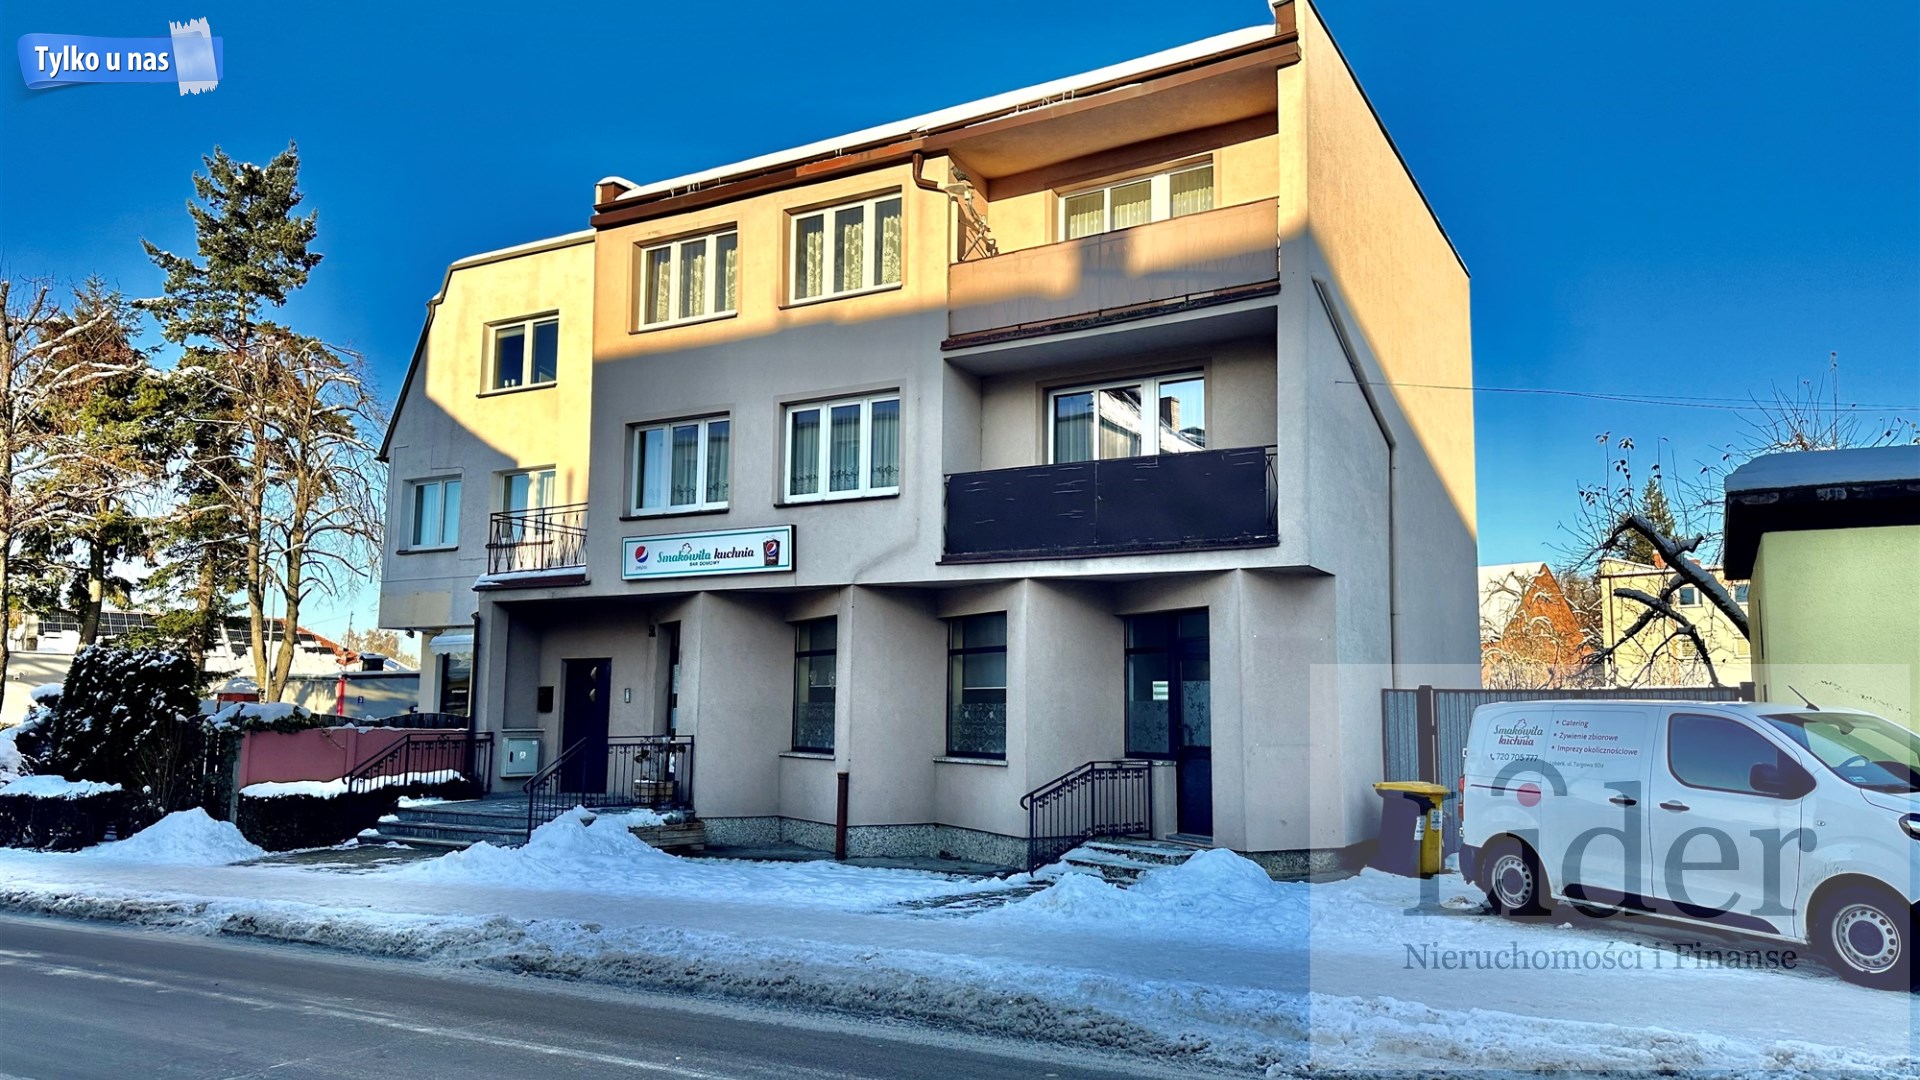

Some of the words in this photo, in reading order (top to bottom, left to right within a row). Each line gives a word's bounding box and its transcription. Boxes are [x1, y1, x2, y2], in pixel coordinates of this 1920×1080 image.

[657, 549, 711, 563] Smakowita
[714, 546, 754, 560] kuchnia
[1561, 720, 1589, 728] Catering
[1493, 724, 1543, 736] Smakowita
[1498, 735, 1534, 746] kuchnia
[1588, 733, 1618, 741] zbiorowe
[1557, 745, 1583, 753] Imprezy
[1584, 746, 1638, 755] okolicznościowe
[1496, 752, 1510, 761] 720
[1511, 753, 1525, 762] 705
[1525, 754, 1539, 762] 777
